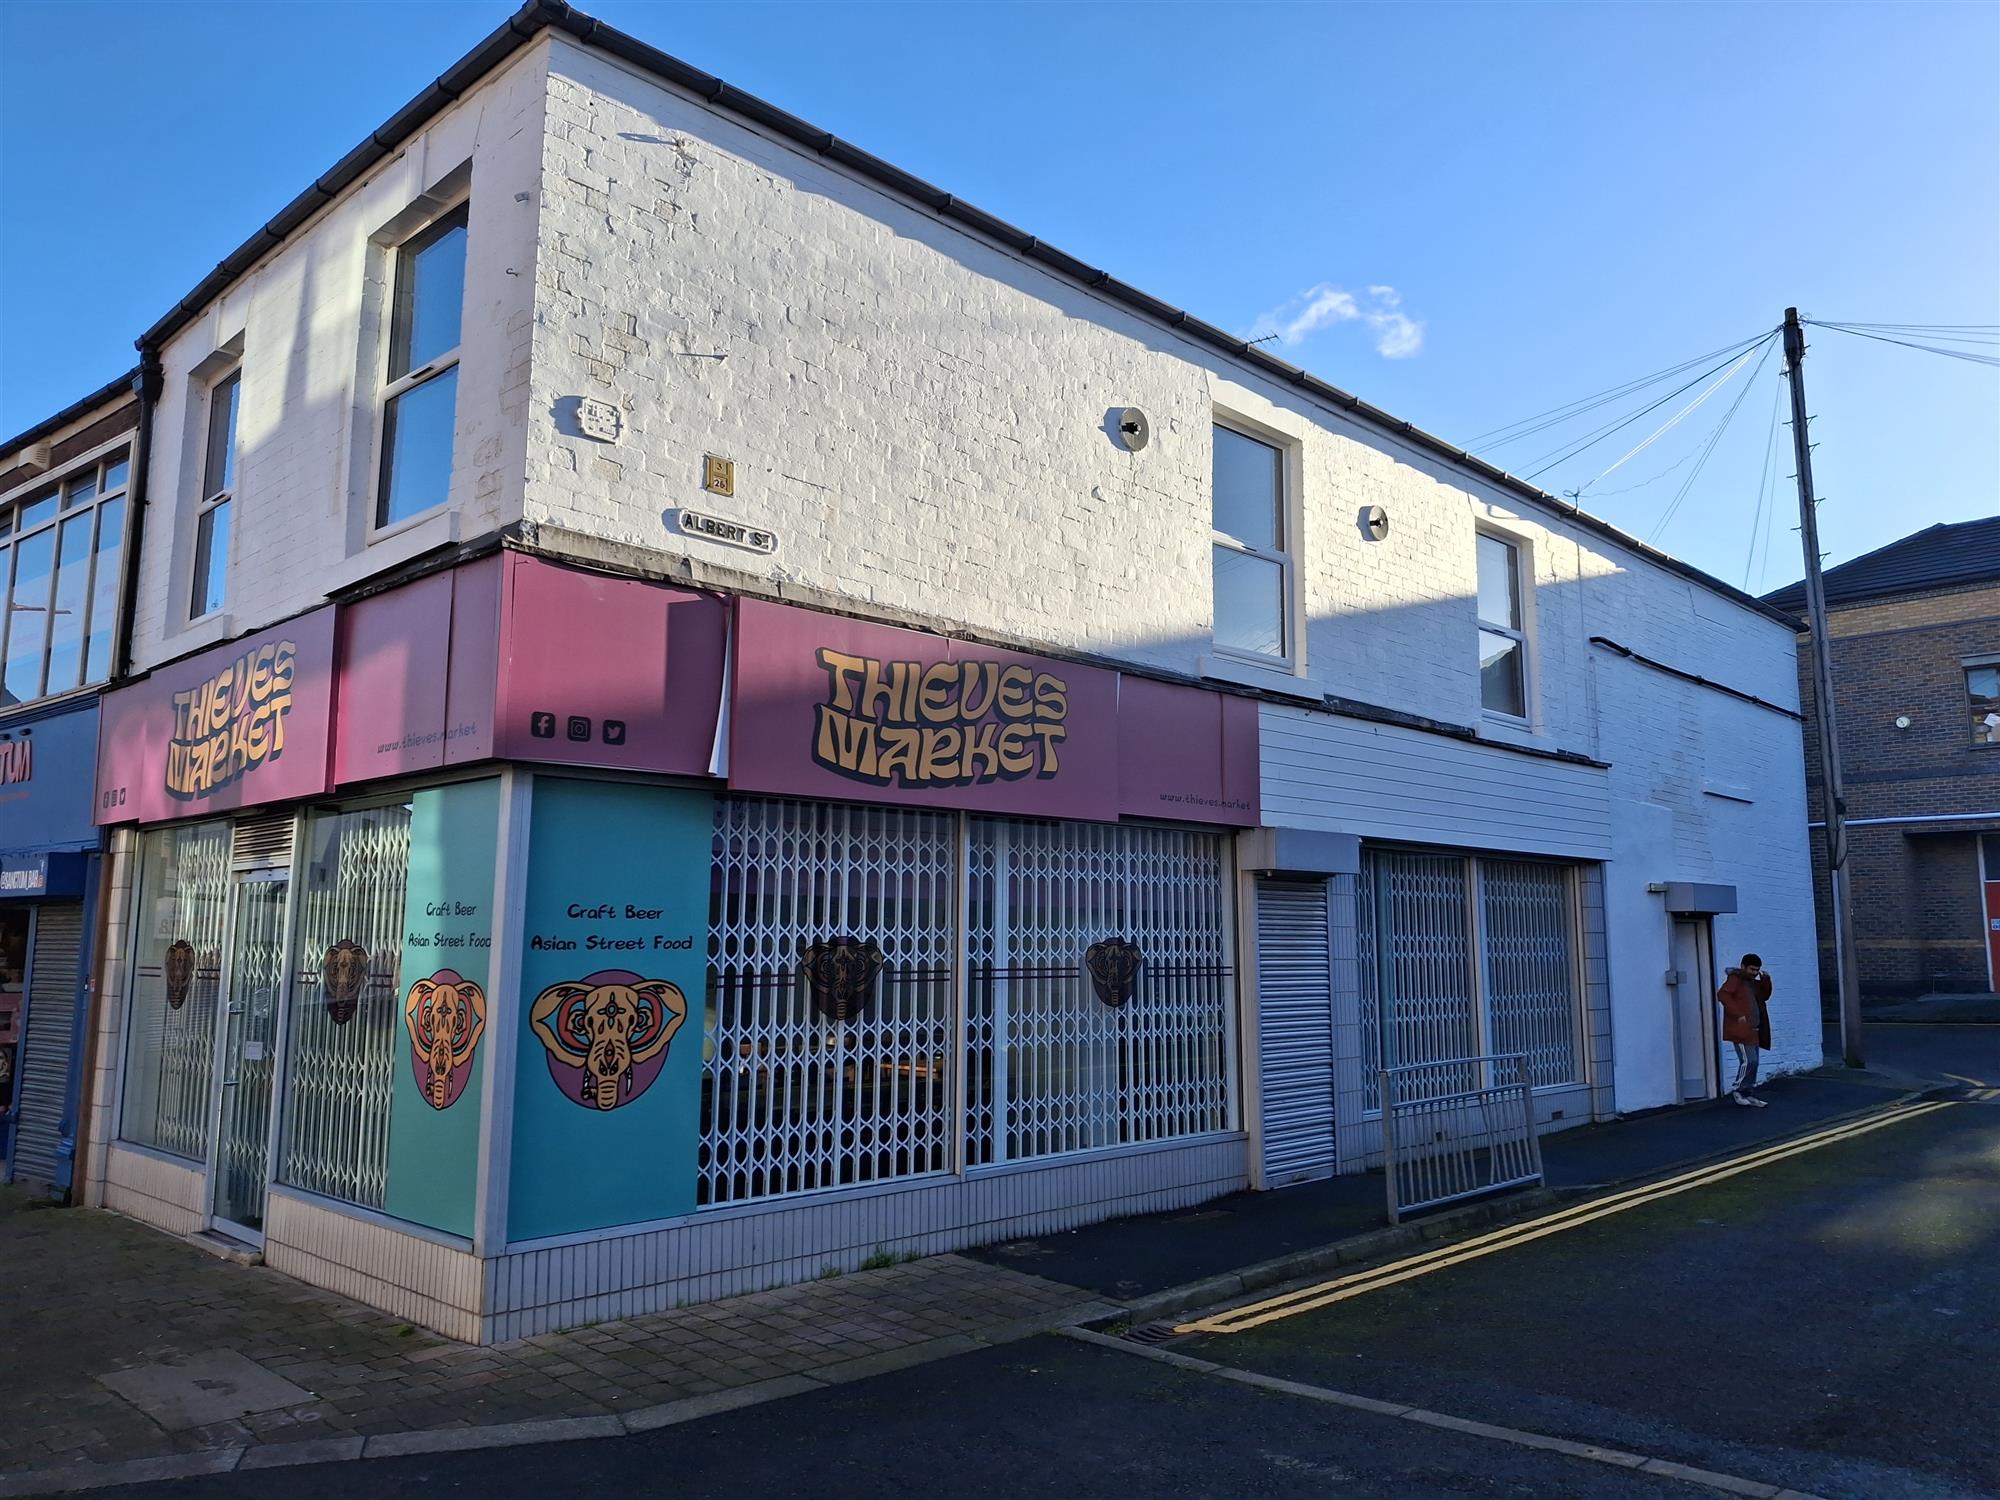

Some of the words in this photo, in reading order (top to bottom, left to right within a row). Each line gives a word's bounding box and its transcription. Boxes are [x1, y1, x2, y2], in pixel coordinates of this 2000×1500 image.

[713, 478, 726, 489] 26
[684, 513, 747, 543] ALBERT
[174, 640, 297, 741] THIEVES
[818, 648, 1069, 724] THIEVES
[165, 692, 292, 797] MARKET
[815, 703, 1068, 785] MARKET
[425, 901, 451, 917] Craft
[454, 901, 477, 917] Beer
[567, 903, 617, 920] Craft
[625, 903, 664, 920] Beer
[408, 932, 430, 948] Asian
[433, 932, 465, 948] Street
[530, 934, 577, 951] Asian
[585, 934, 646, 951] Street
[653, 935, 694, 951] Food
